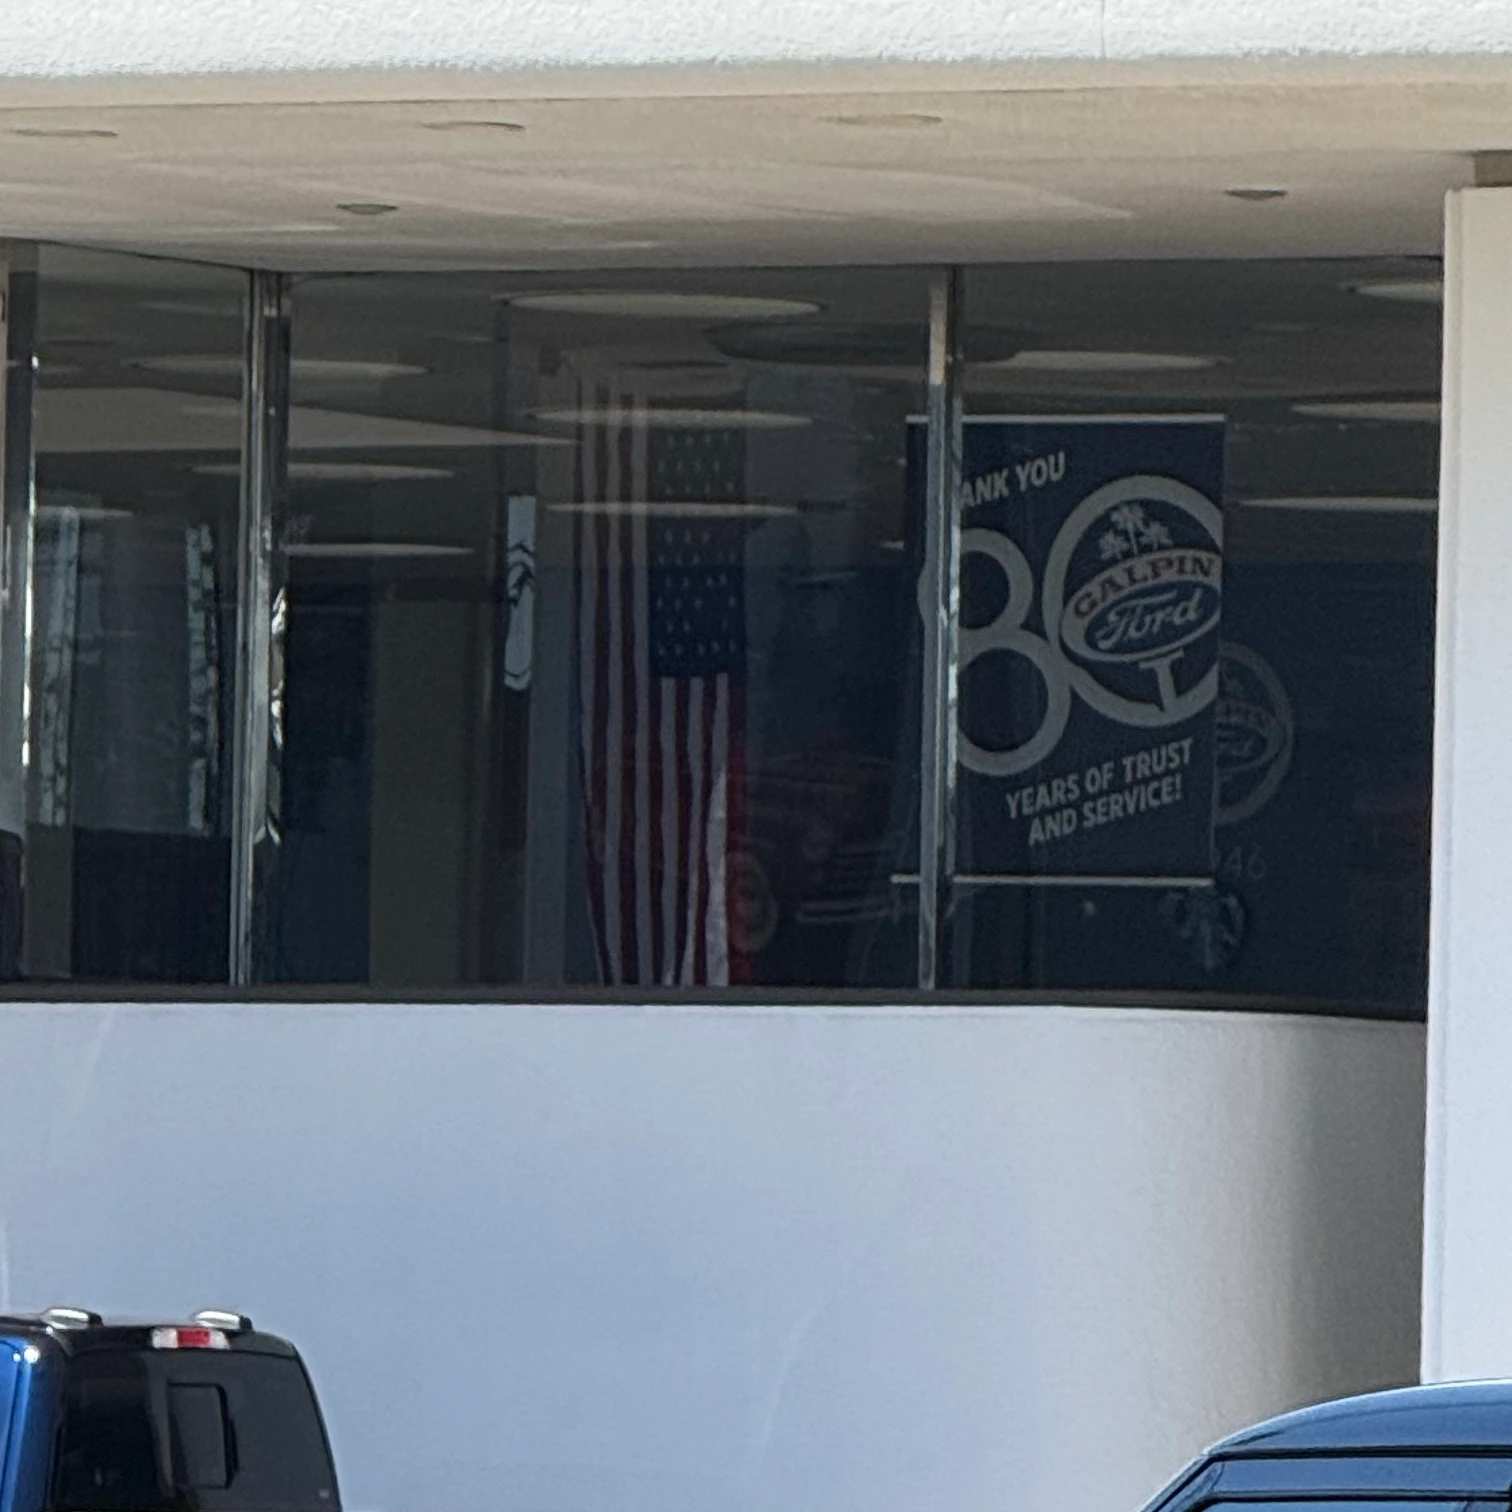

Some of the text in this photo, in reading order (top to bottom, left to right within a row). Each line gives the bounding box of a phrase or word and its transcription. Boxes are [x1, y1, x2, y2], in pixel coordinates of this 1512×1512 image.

[961, 451, 1066, 508] ANK YOU
[1074, 553, 1216, 619] GALPIN
[1095, 589, 1202, 649] Ford
[1006, 774, 1080, 819] YEARS
[1085, 761, 1113, 792] OF
[1123, 738, 1193, 776] TRUST
[1029, 776, 1184, 846] AND SERVICE!
